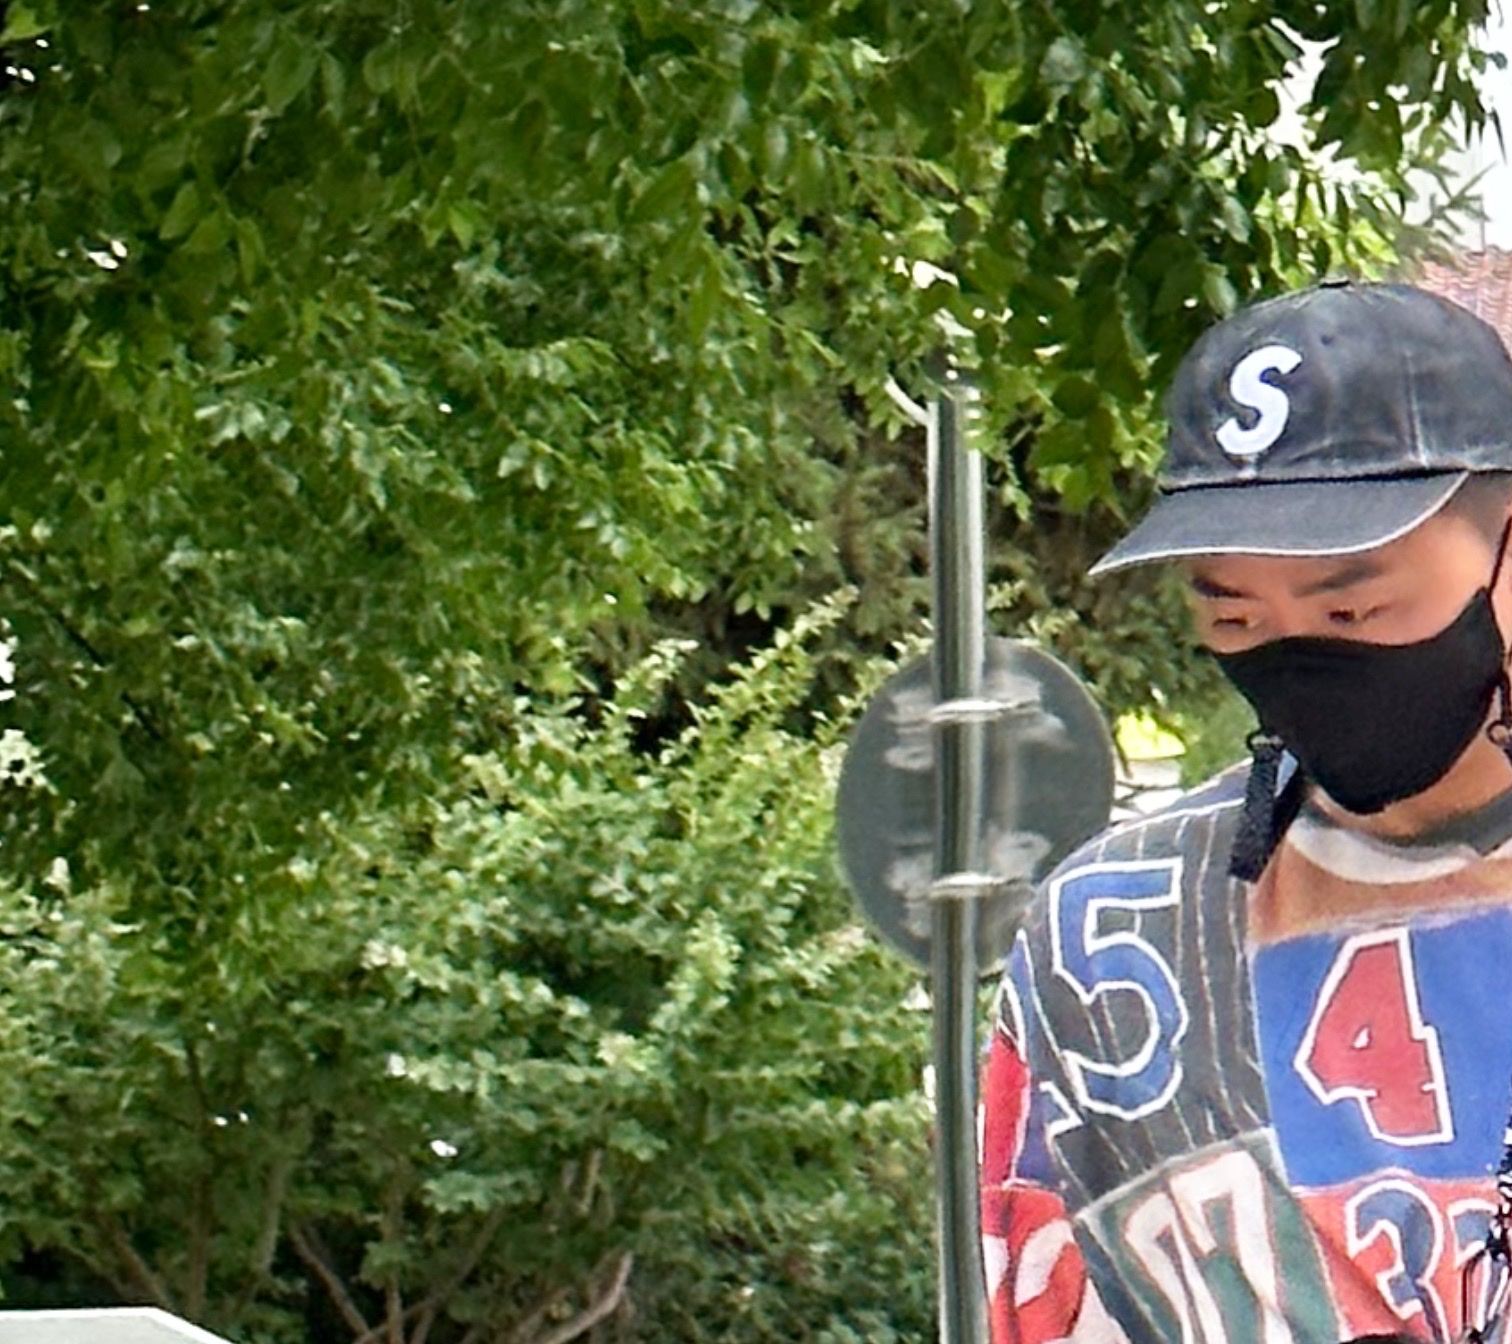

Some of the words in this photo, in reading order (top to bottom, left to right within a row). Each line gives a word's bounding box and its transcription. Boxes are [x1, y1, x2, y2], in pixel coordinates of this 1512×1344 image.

[1215, 345, 1302, 455] S
[1049, 857, 1190, 1121] 5
[1293, 926, 1455, 1147] 4
